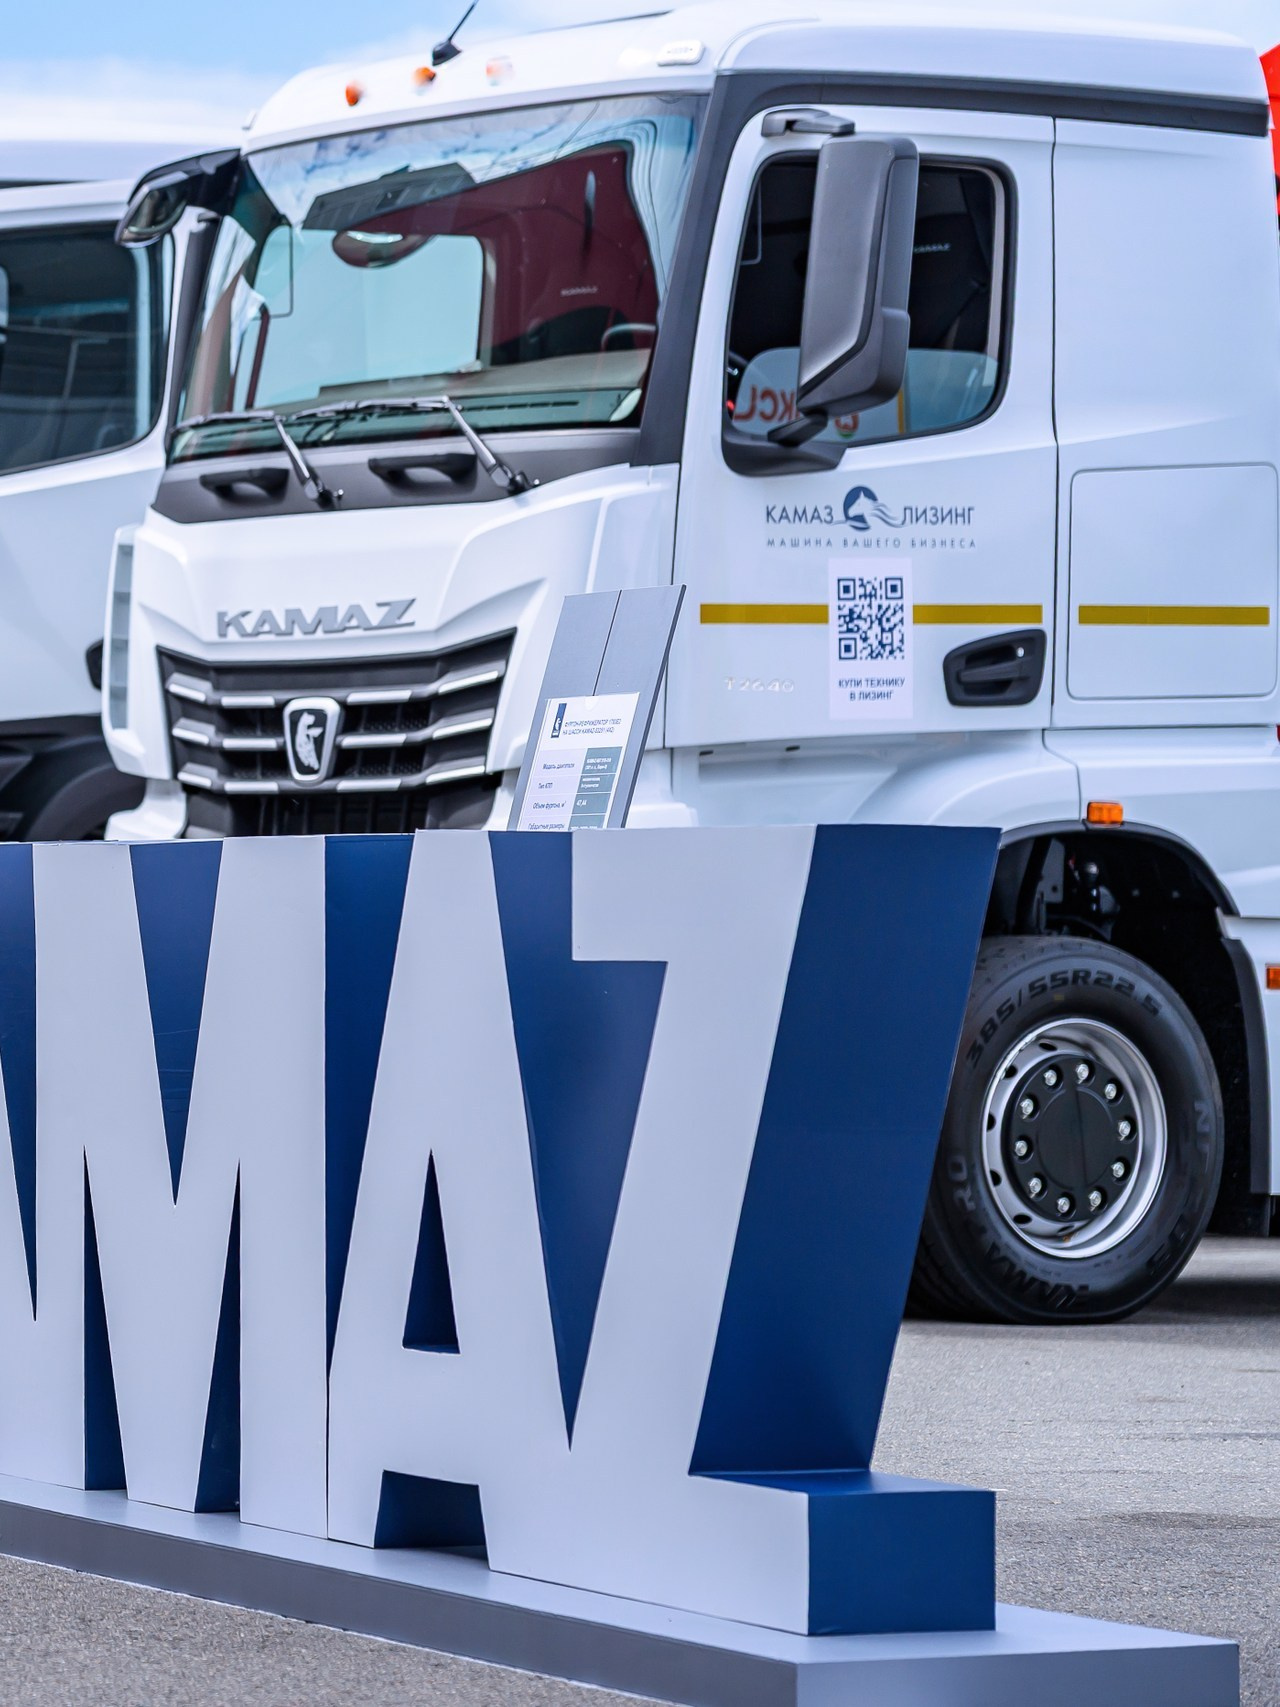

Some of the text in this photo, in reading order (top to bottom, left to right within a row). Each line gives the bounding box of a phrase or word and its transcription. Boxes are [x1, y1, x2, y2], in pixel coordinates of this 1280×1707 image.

[765, 505, 976, 526] КАМАЗ ЛИЗИНГ
[766, 537, 977, 549] МАШИНА ВАШЕГО БИЗНЕСА
[216, 598, 417, 638] KAMAZ
[838, 677, 906, 689] КУПИ ТЕХНИКУ
[849, 690, 894, 701] В ЛИЗИНГ
